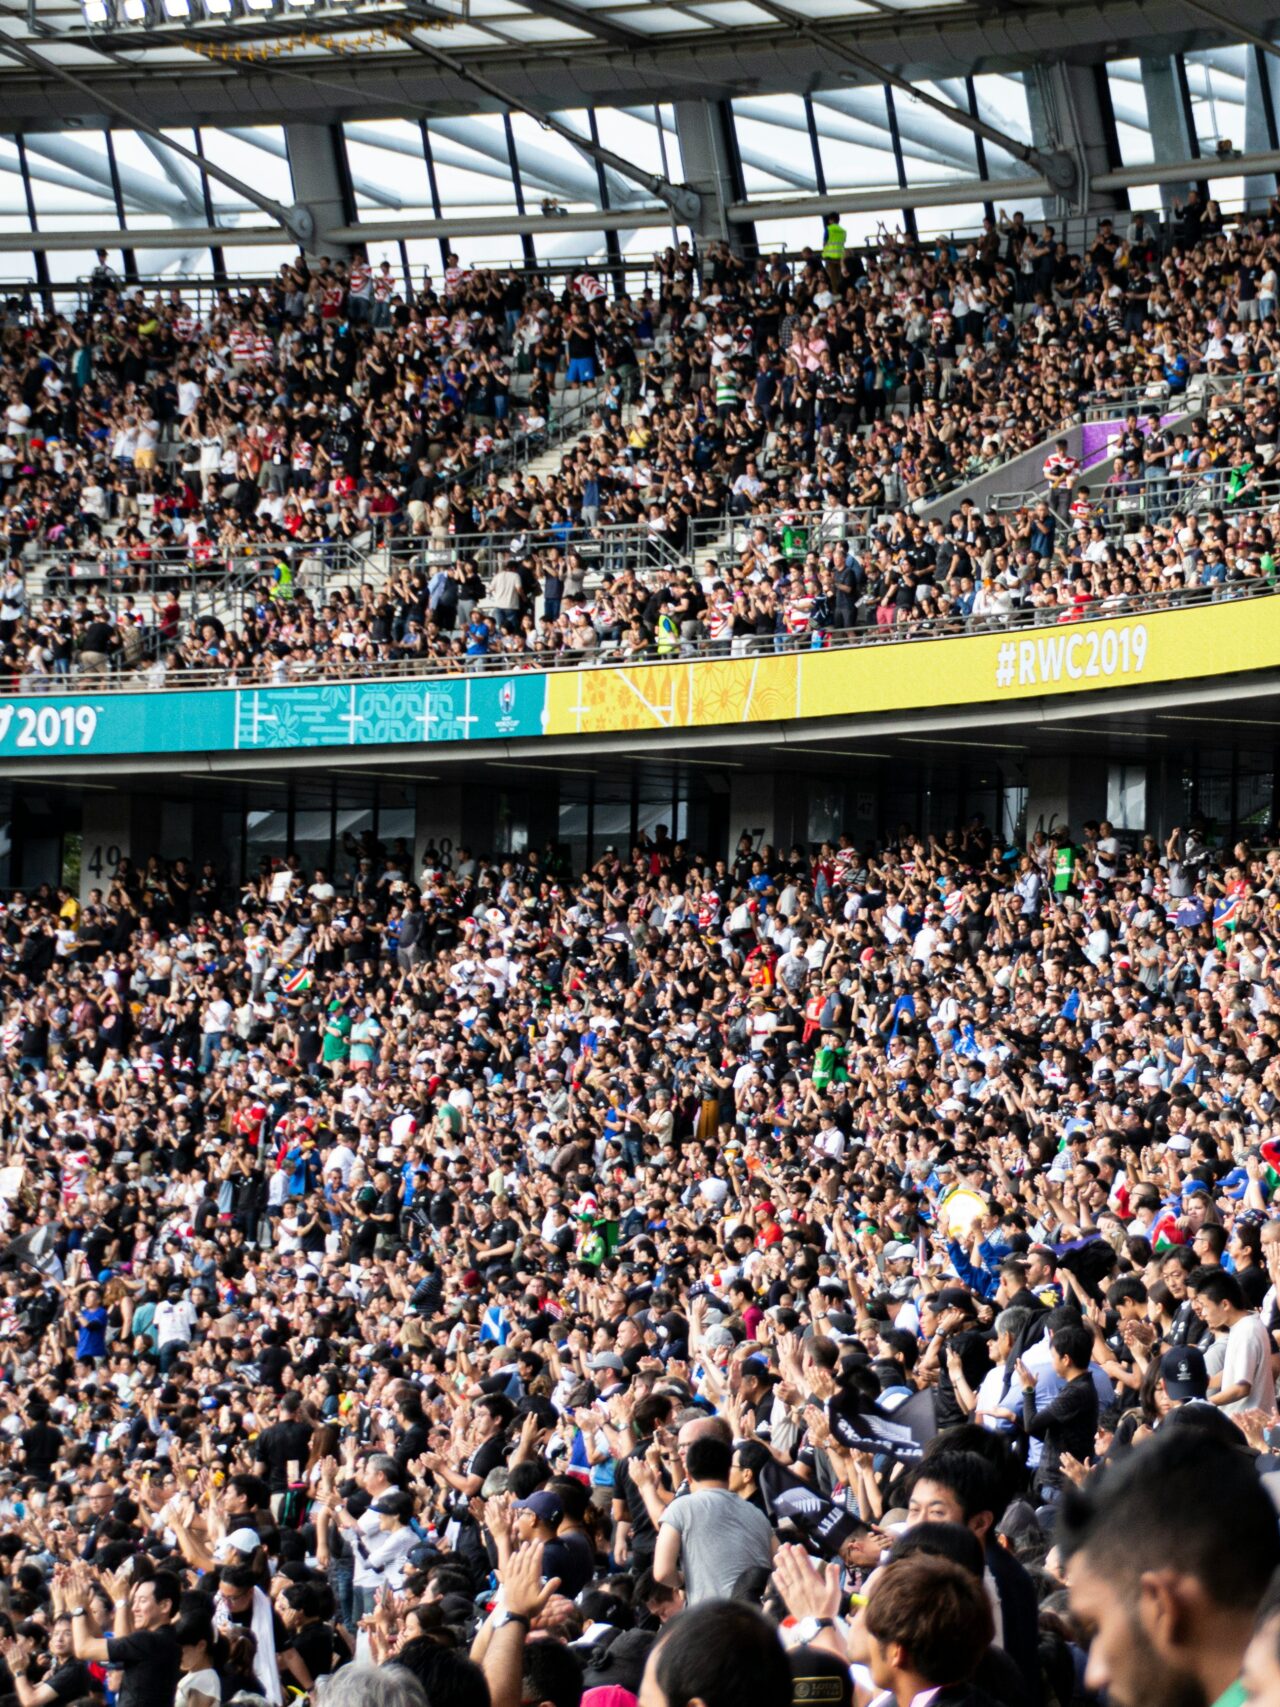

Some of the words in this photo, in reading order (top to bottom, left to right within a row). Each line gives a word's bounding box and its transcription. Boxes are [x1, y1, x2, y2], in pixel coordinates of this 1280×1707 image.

[995, 624, 1149, 688] #RWC2019
[16, 705, 97, 747] 2019
[88, 845, 121, 879] 49
